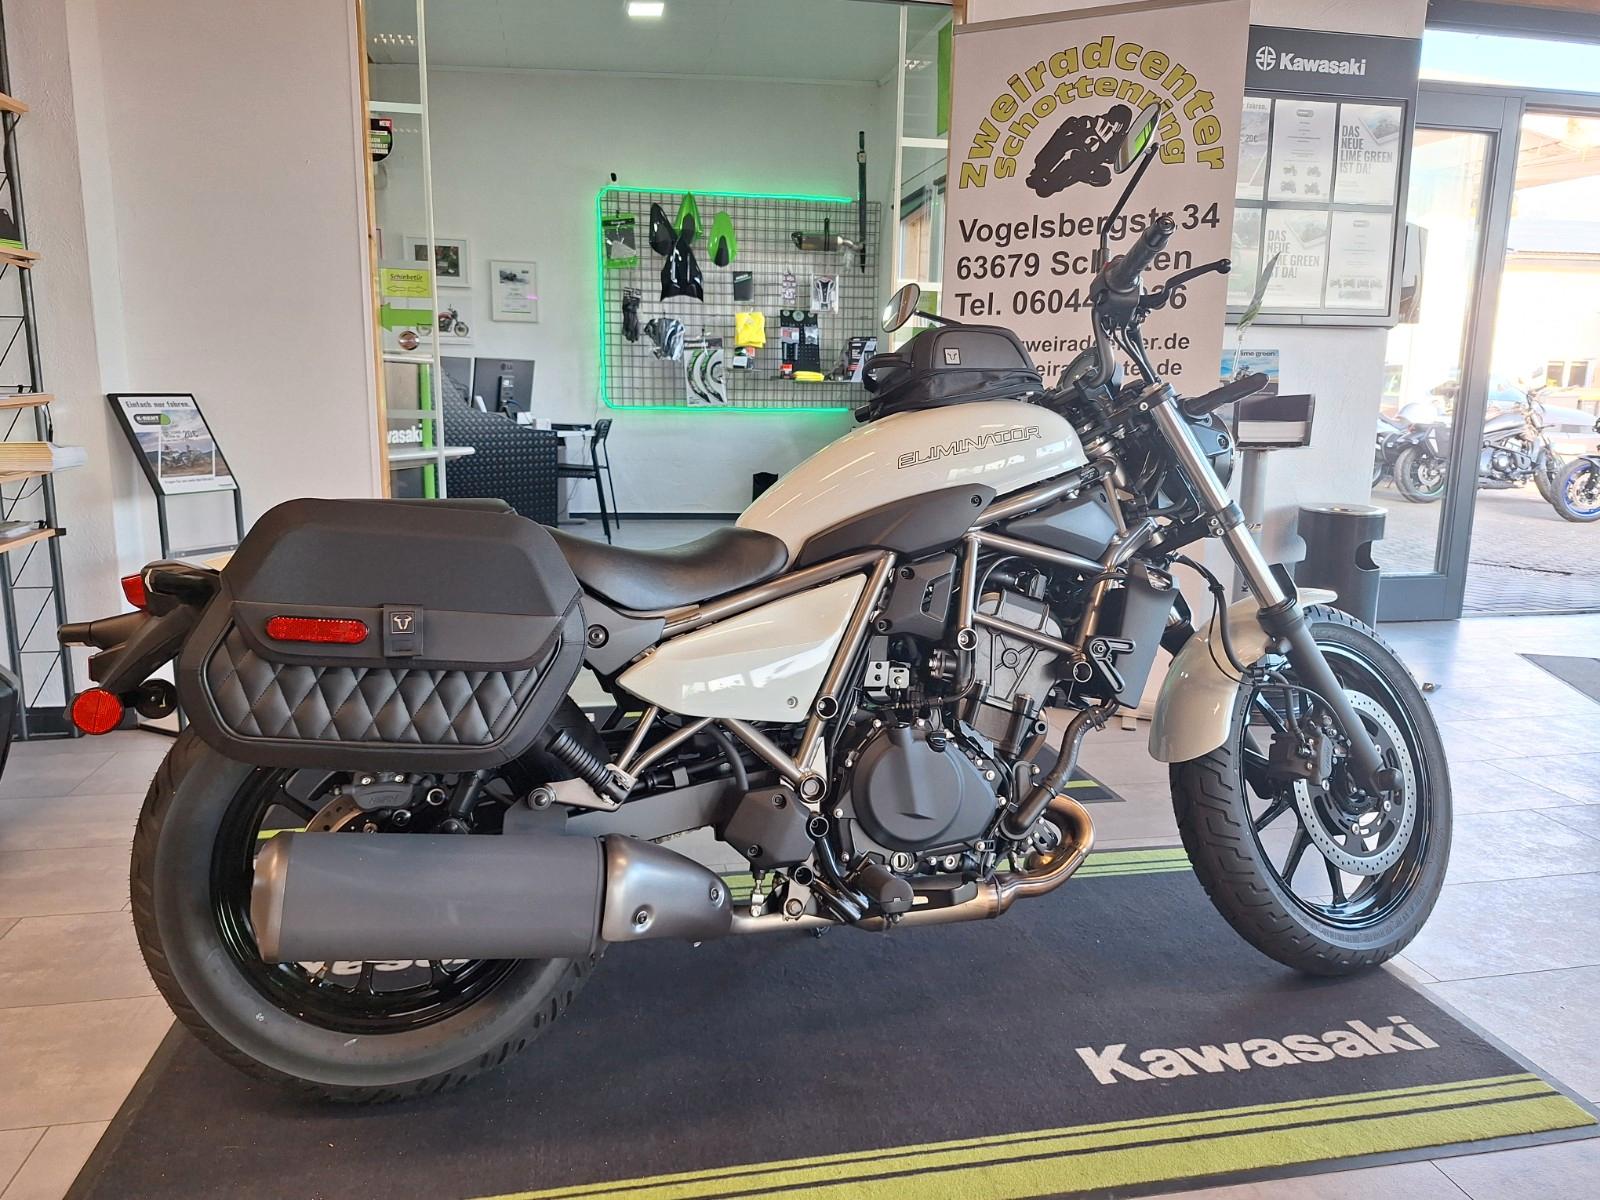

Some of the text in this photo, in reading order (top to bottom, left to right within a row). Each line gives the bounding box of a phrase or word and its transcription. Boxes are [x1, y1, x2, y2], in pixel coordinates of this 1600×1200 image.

[1279, 52, 1367, 76] Kawasaki
[959, 36, 1225, 190] Zweiradcenter
[1342, 125, 1360, 138] DAS
[1341, 137, 1364, 150] NEUE
[1340, 149, 1393, 164] LIME GREEN
[1339, 162, 1353, 174] IST
[1267, 229, 1287, 242] DAS
[1266, 241, 1291, 254] NEUE
[956, 249, 1192, 281] 63679 Scen
[1290, 255, 1320, 267] GREEN
[954, 292, 1001, 317] Tel.
[125, 400, 152, 408] Einfach
[897, 425, 1042, 470] ELIMINATOR
[1074, 1015, 1440, 1085] Kawasaki
